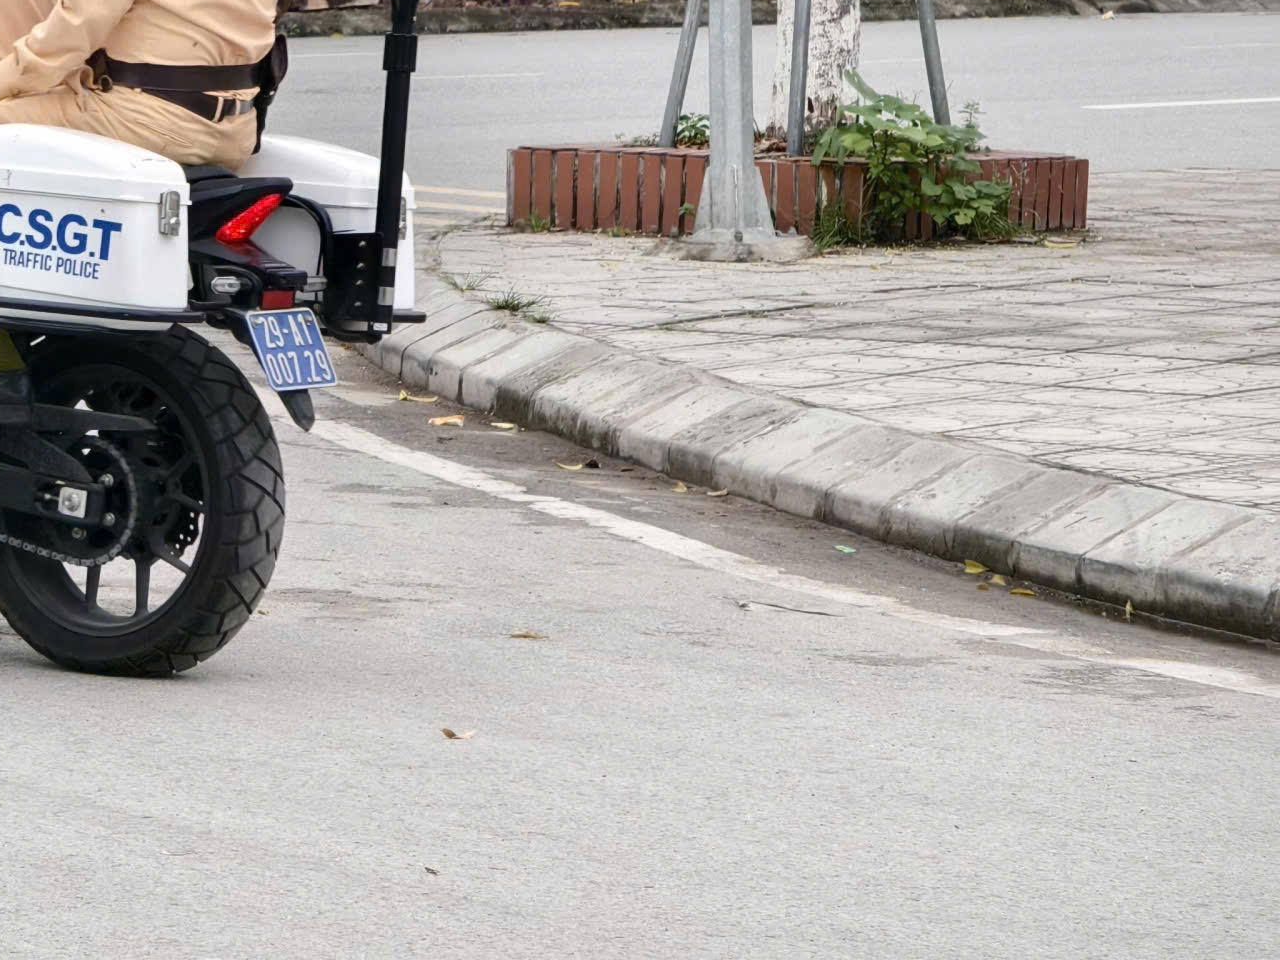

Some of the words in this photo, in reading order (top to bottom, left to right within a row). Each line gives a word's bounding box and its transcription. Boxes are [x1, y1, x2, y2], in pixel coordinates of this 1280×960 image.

[3, 248, 52, 272] TRAFFIC
[55, 257, 101, 280] POLICE
[254, 313, 313, 349] 29-A1
[265, 349, 332, 385] 007.29
